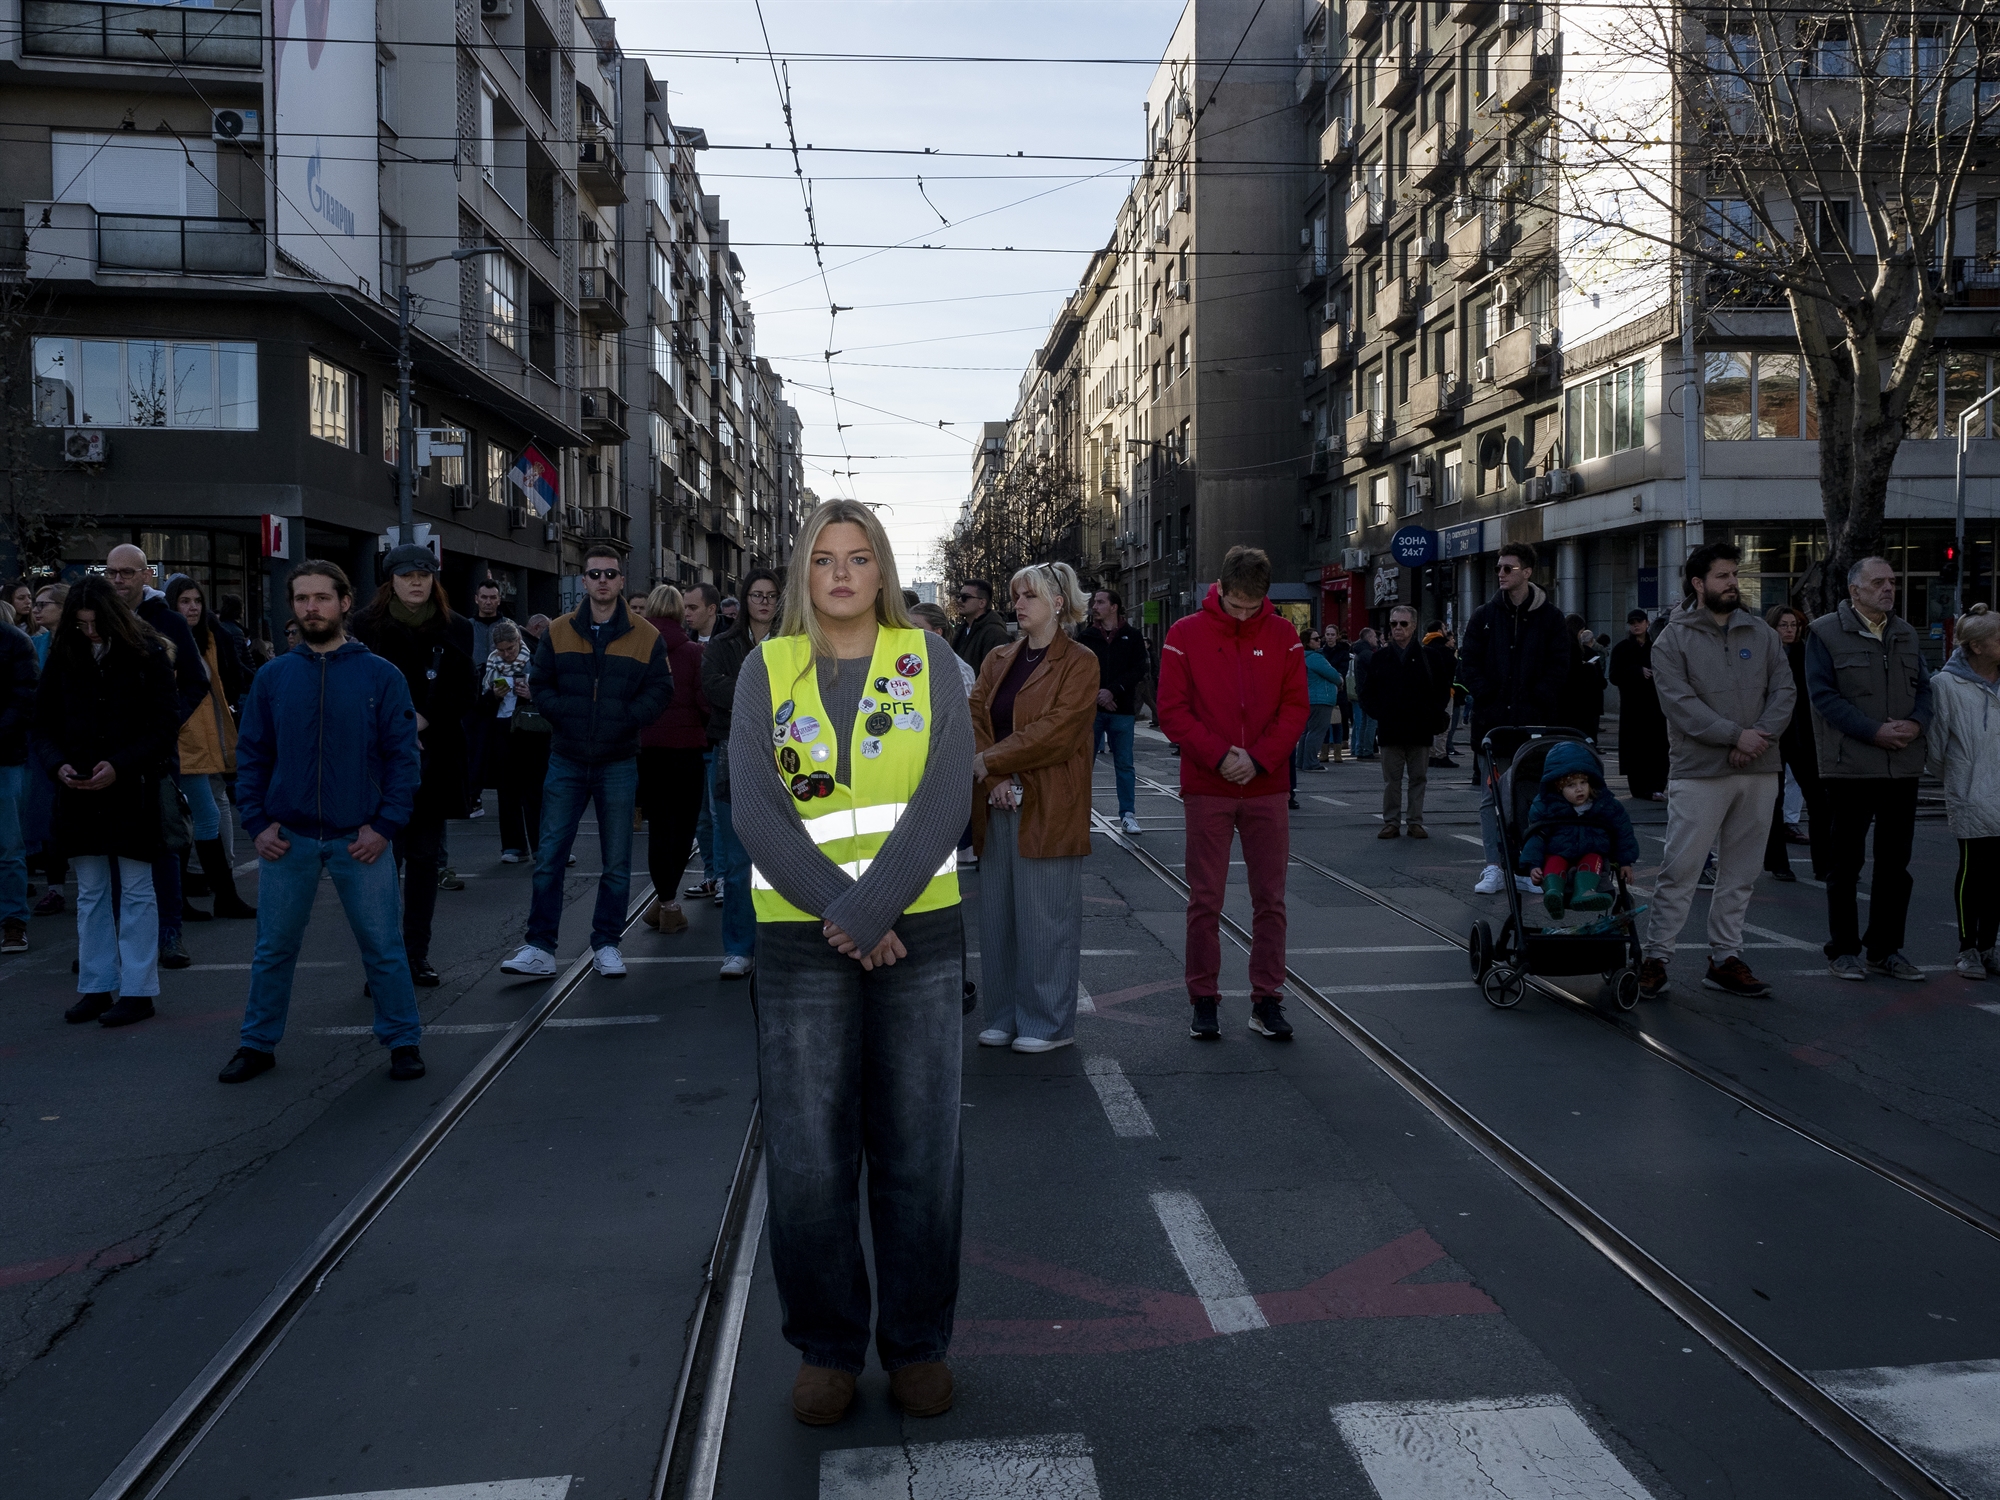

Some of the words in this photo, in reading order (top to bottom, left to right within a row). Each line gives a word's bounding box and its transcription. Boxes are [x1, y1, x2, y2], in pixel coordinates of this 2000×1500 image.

[322, 190, 354, 240] ГАЗПРОМ
[1398, 536, 1427, 546] ЗОНА
[1401, 548, 1424, 557] 24x7
